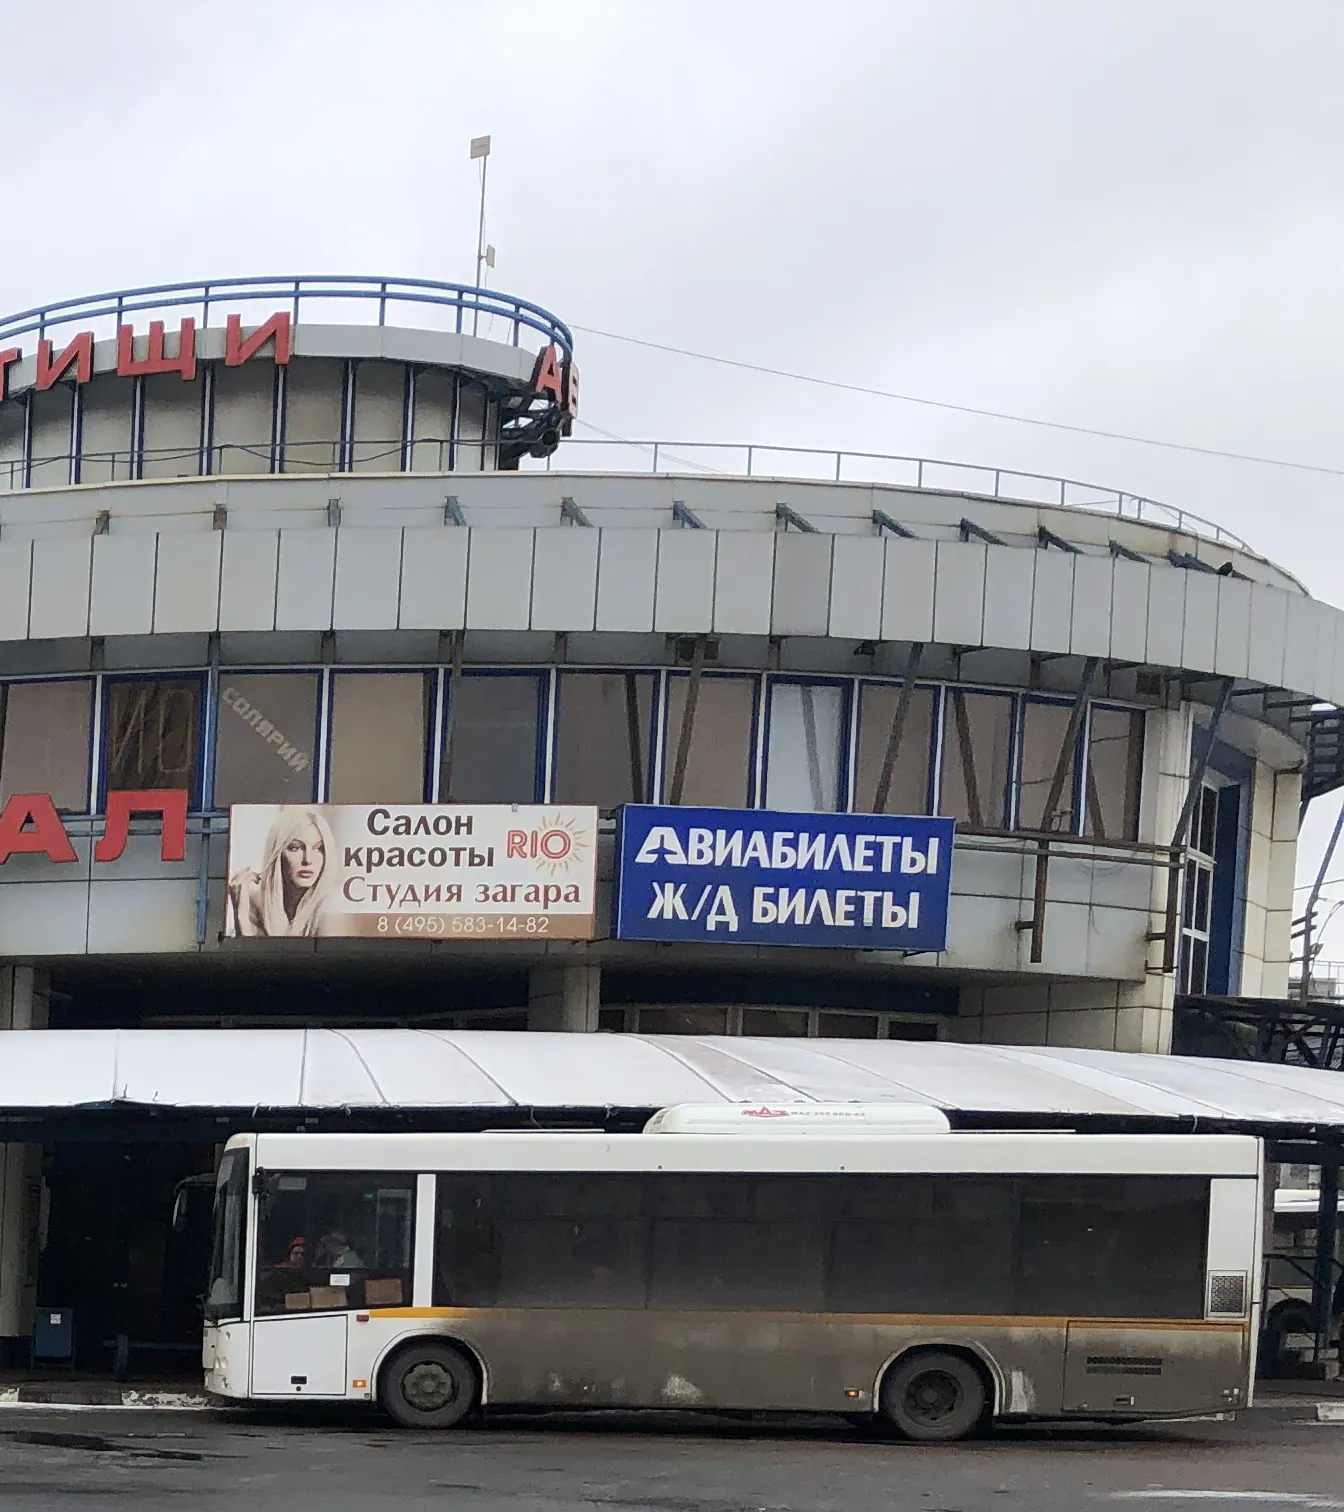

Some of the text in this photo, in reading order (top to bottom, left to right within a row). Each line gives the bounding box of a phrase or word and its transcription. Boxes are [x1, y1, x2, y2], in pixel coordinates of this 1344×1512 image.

[367, 808, 474, 836] Салон
[506, 829, 572, 859] RIO
[635, 826, 940, 875] АВИАБИЛЕТЫ
[343, 846, 495, 874] красоты
[342, 876, 582, 910] Студия загара
[647, 881, 921, 932] Ж/Д БИЛЕТЫ
[377, 915, 550, 934] 8 (495) 583-14-82
